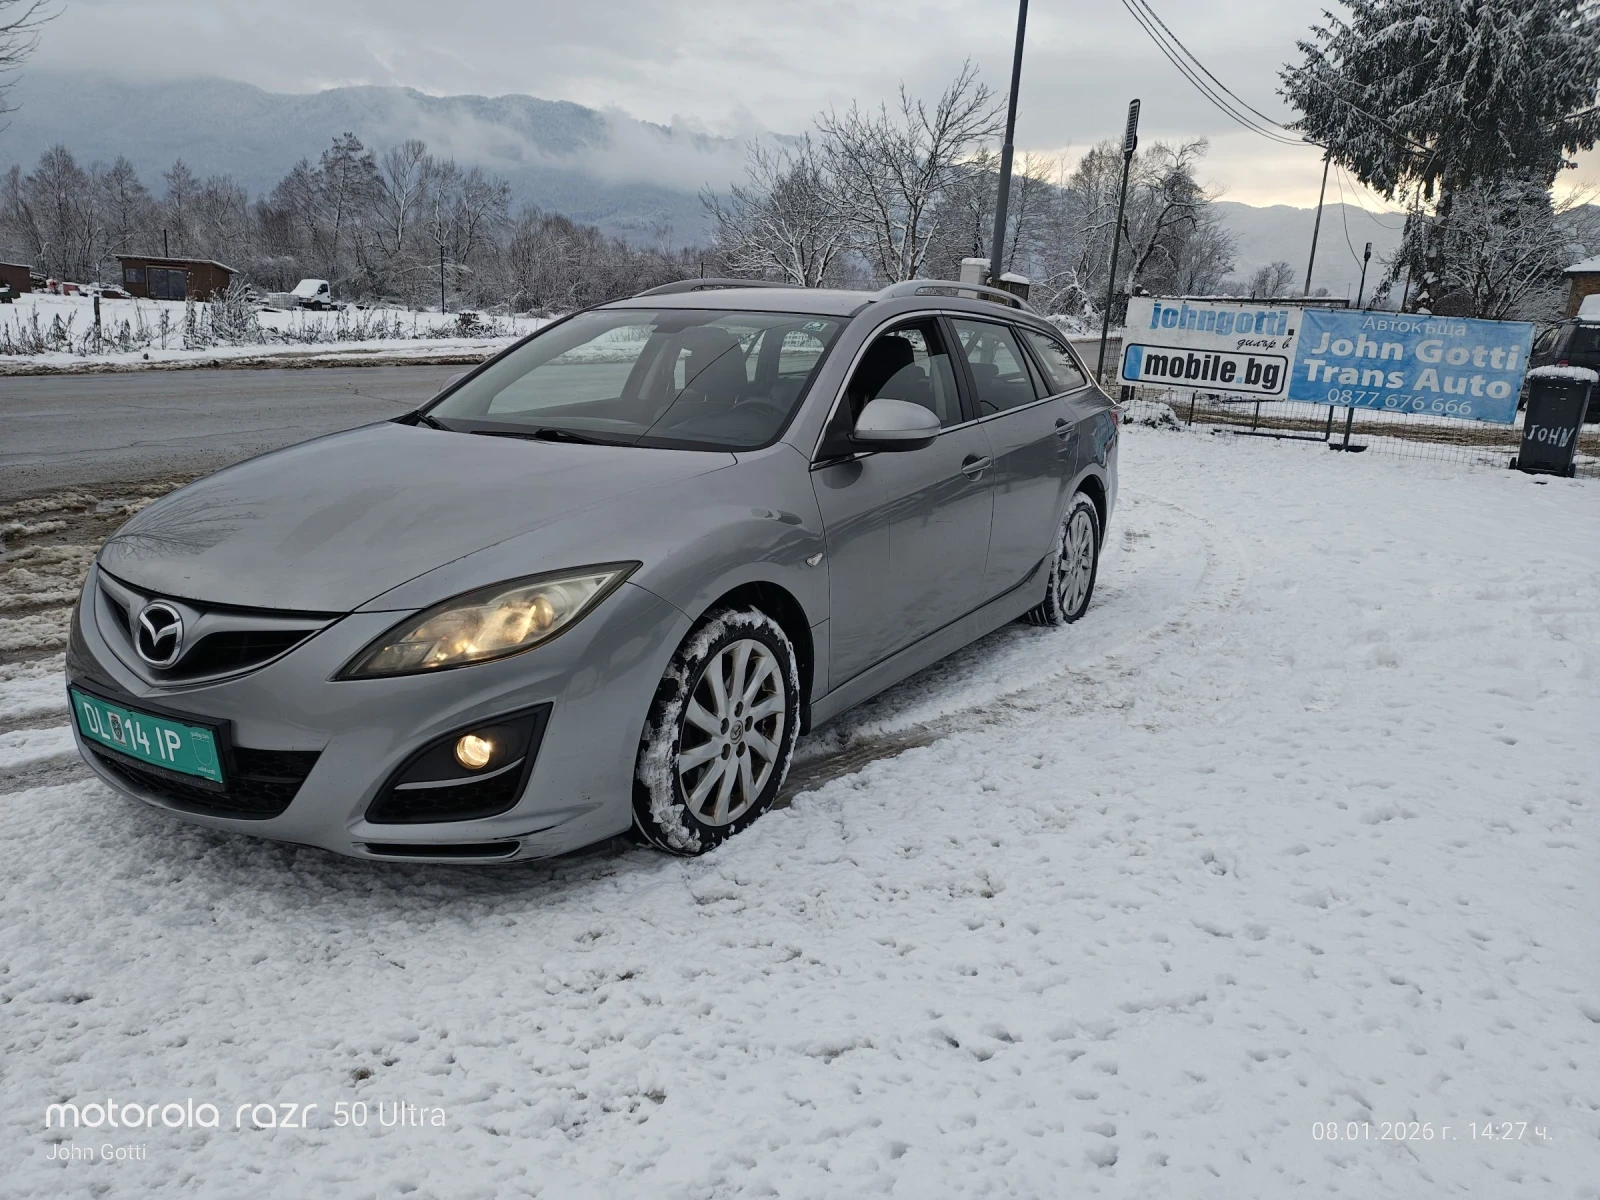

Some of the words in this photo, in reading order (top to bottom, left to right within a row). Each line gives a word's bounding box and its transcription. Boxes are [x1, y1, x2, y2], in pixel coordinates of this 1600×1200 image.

[1362, 316, 1467, 338] Автокъща
[1311, 332, 1404, 360] John
[1415, 339, 1522, 370] Gotti
[1143, 352, 1281, 390] mobile.bg
[1303, 359, 1405, 388] Trans
[1413, 368, 1512, 399] Auto
[1327, 388, 1380, 404] 0877
[1385, 393, 1425, 410] 676
[1431, 398, 1472, 415] 666
[1525, 424, 1575, 447] JOHN
